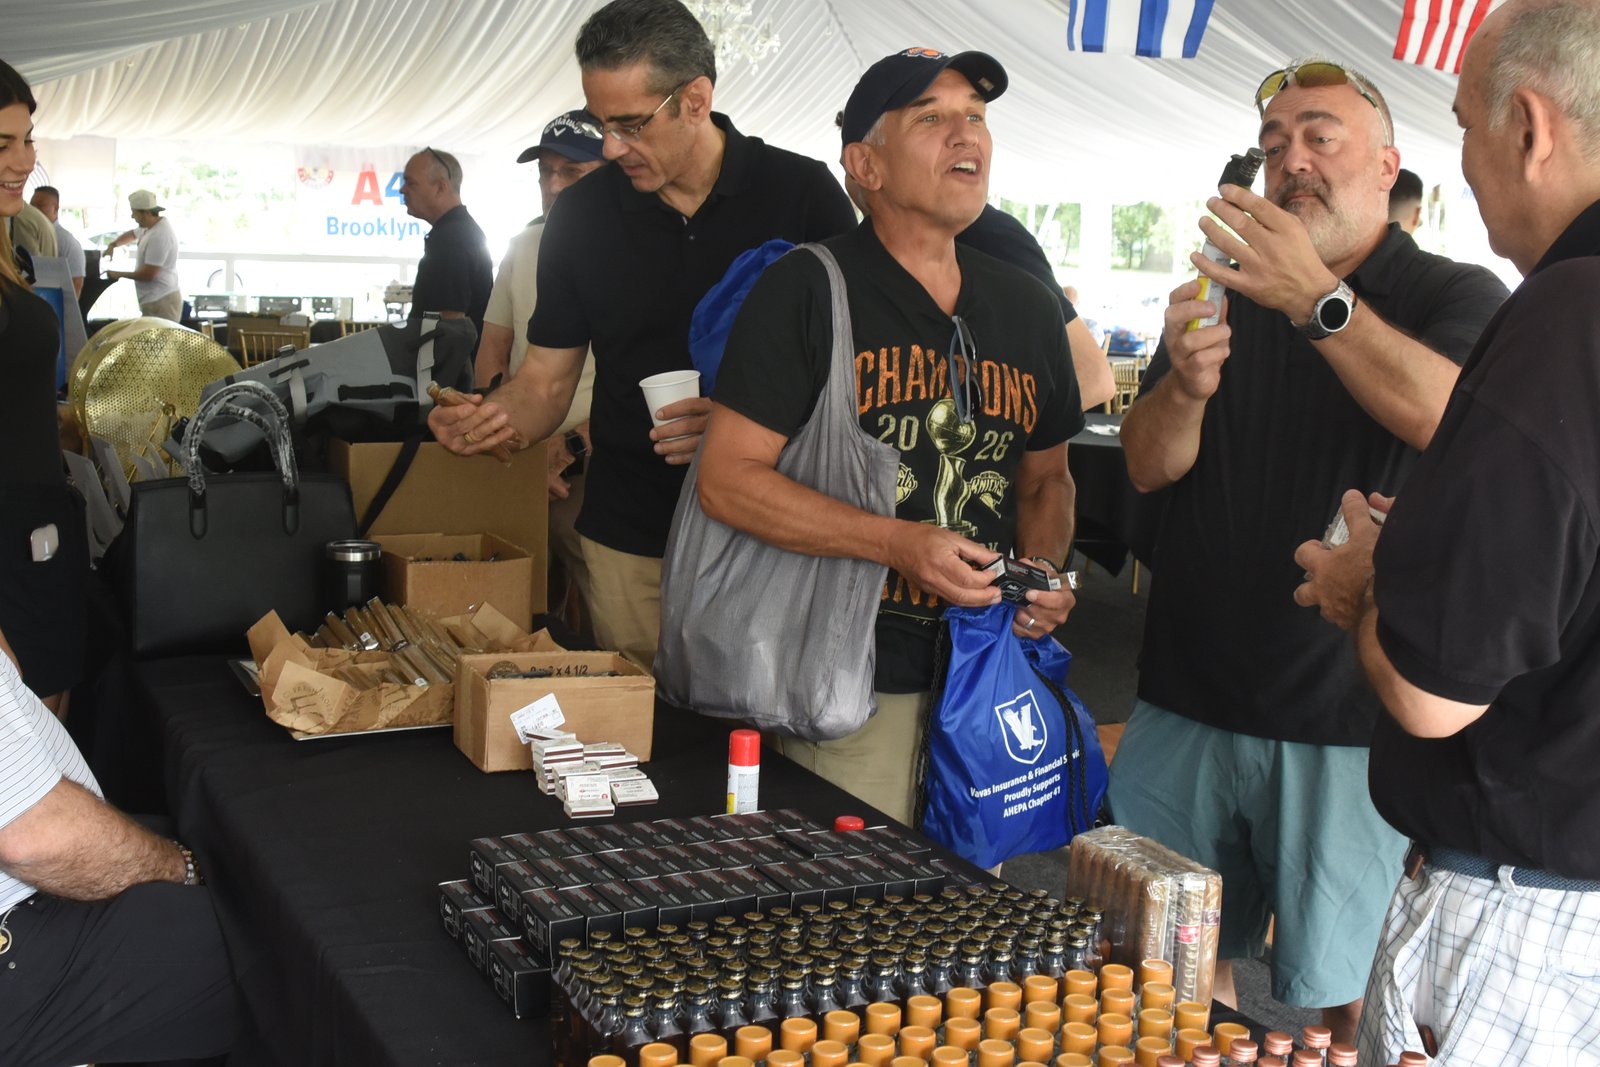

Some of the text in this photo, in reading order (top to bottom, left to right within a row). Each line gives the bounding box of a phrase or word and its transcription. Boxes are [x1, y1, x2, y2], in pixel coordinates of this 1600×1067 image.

[544, 117, 582, 134] Callaway
[855, 344, 1038, 434] CHAMPONS
[877, 413, 1014, 462] 20 26
[971, 478, 1005, 497] KNICKS
[564, 665, 571, 675] 4
[574, 664, 588, 675] 1/2
[992, 774, 1027, 794] Insurance
[1027, 770, 1034, 780] &
[1034, 756, 1063, 778] Financial
[1004, 773, 1061, 804] Proudly Supports
[1003, 786, 1061, 819] AHEPA Chapter 41
